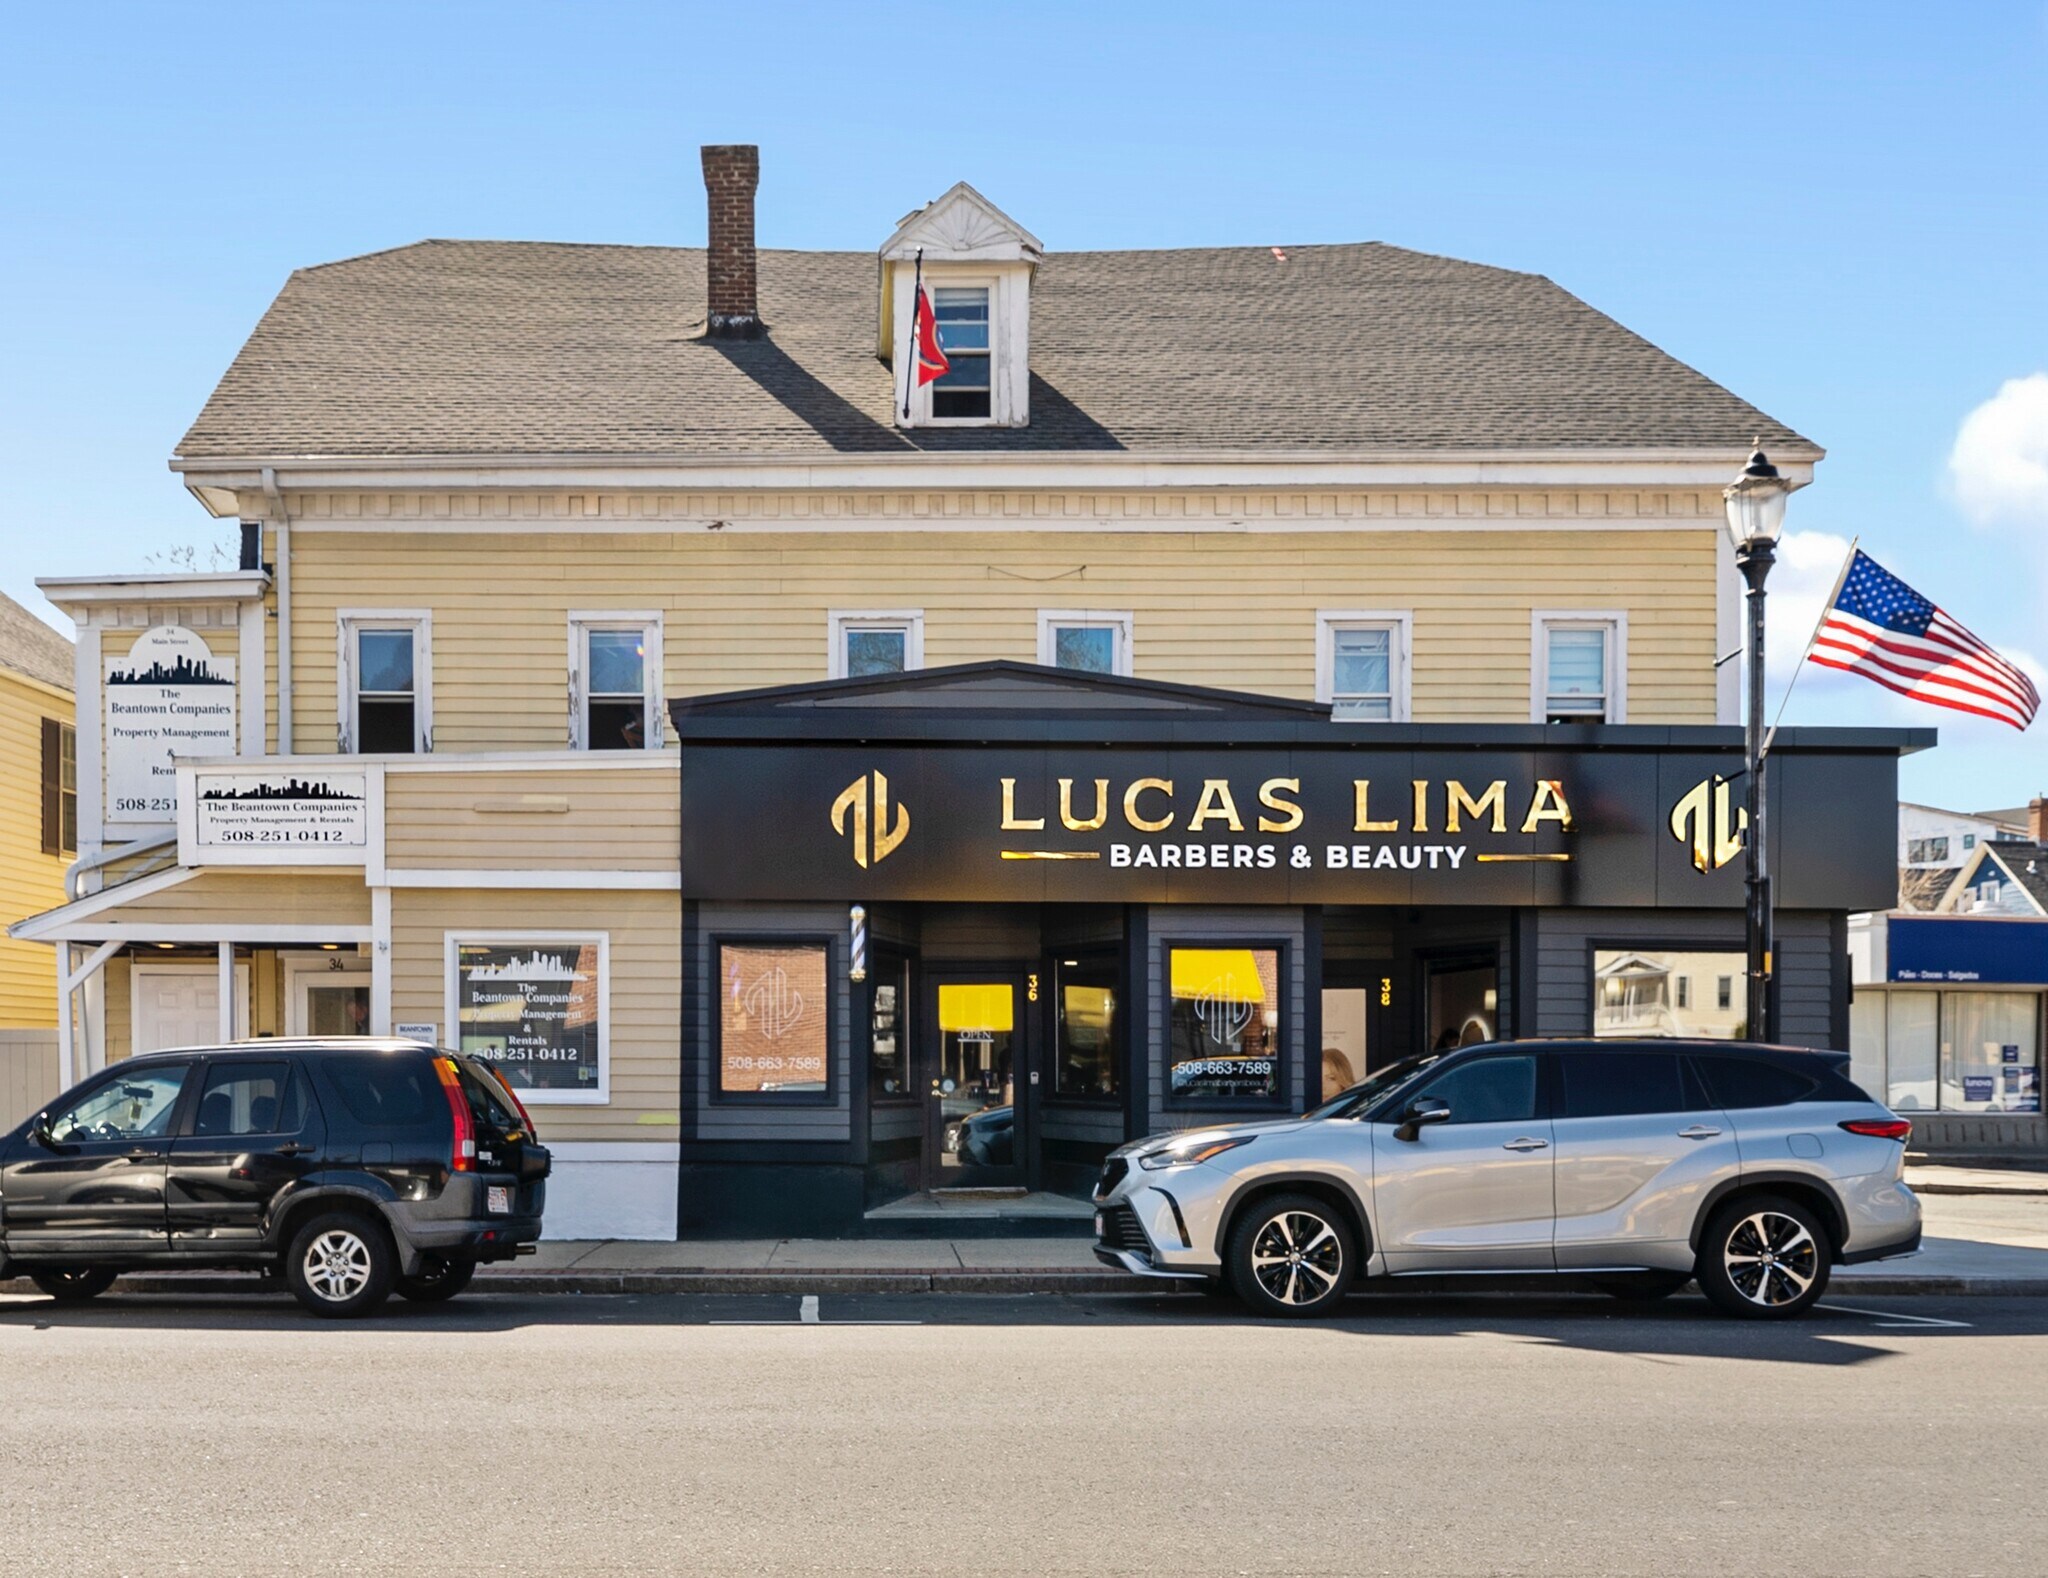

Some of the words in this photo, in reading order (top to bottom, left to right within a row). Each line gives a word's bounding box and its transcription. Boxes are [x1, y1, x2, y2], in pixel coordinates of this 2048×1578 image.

[160, 689, 181, 699] The
[111, 702, 167, 714] Beantown
[169, 703, 231, 717] Companies
[113, 728, 159, 739] Property
[162, 728, 230, 739] Management
[166, 748, 175, 758] &
[152, 766, 177, 775] Rent
[116, 799, 177, 811] 508-251
[206, 802, 229, 812] The
[231, 802, 290, 812] Beantown
[293, 802, 358, 814] Companies
[1000, 777, 1305, 833] LUCAS
[1353, 779, 1574, 833] LIMA
[209, 816, 248, 824] Property
[251, 816, 307, 824] Management
[221, 830, 343, 842] 508-251-0412
[1109, 843, 1277, 868] BARBERS
[1289, 844, 1313, 868] &
[1326, 845, 1467, 869] BEAUTY
[329, 958, 344, 970] 34
[517, 983, 538, 993] The
[1028, 974, 1038, 1002] 36
[1381, 978, 1391, 1006] 38
[472, 991, 524, 1003] Beantown
[526, 992, 584, 1006] Companies
[519, 1009, 582, 1021] Management
[399, 1025, 433, 1033] BEANTOWN
[523, 1023, 532, 1033] &
[508, 1035, 548, 1046] Rentals
[961, 1030, 992, 1039] OPEN
[727, 1056, 821, 1070] 508-663-7589
[1176, 1061, 1272, 1075] 508-663-7589
